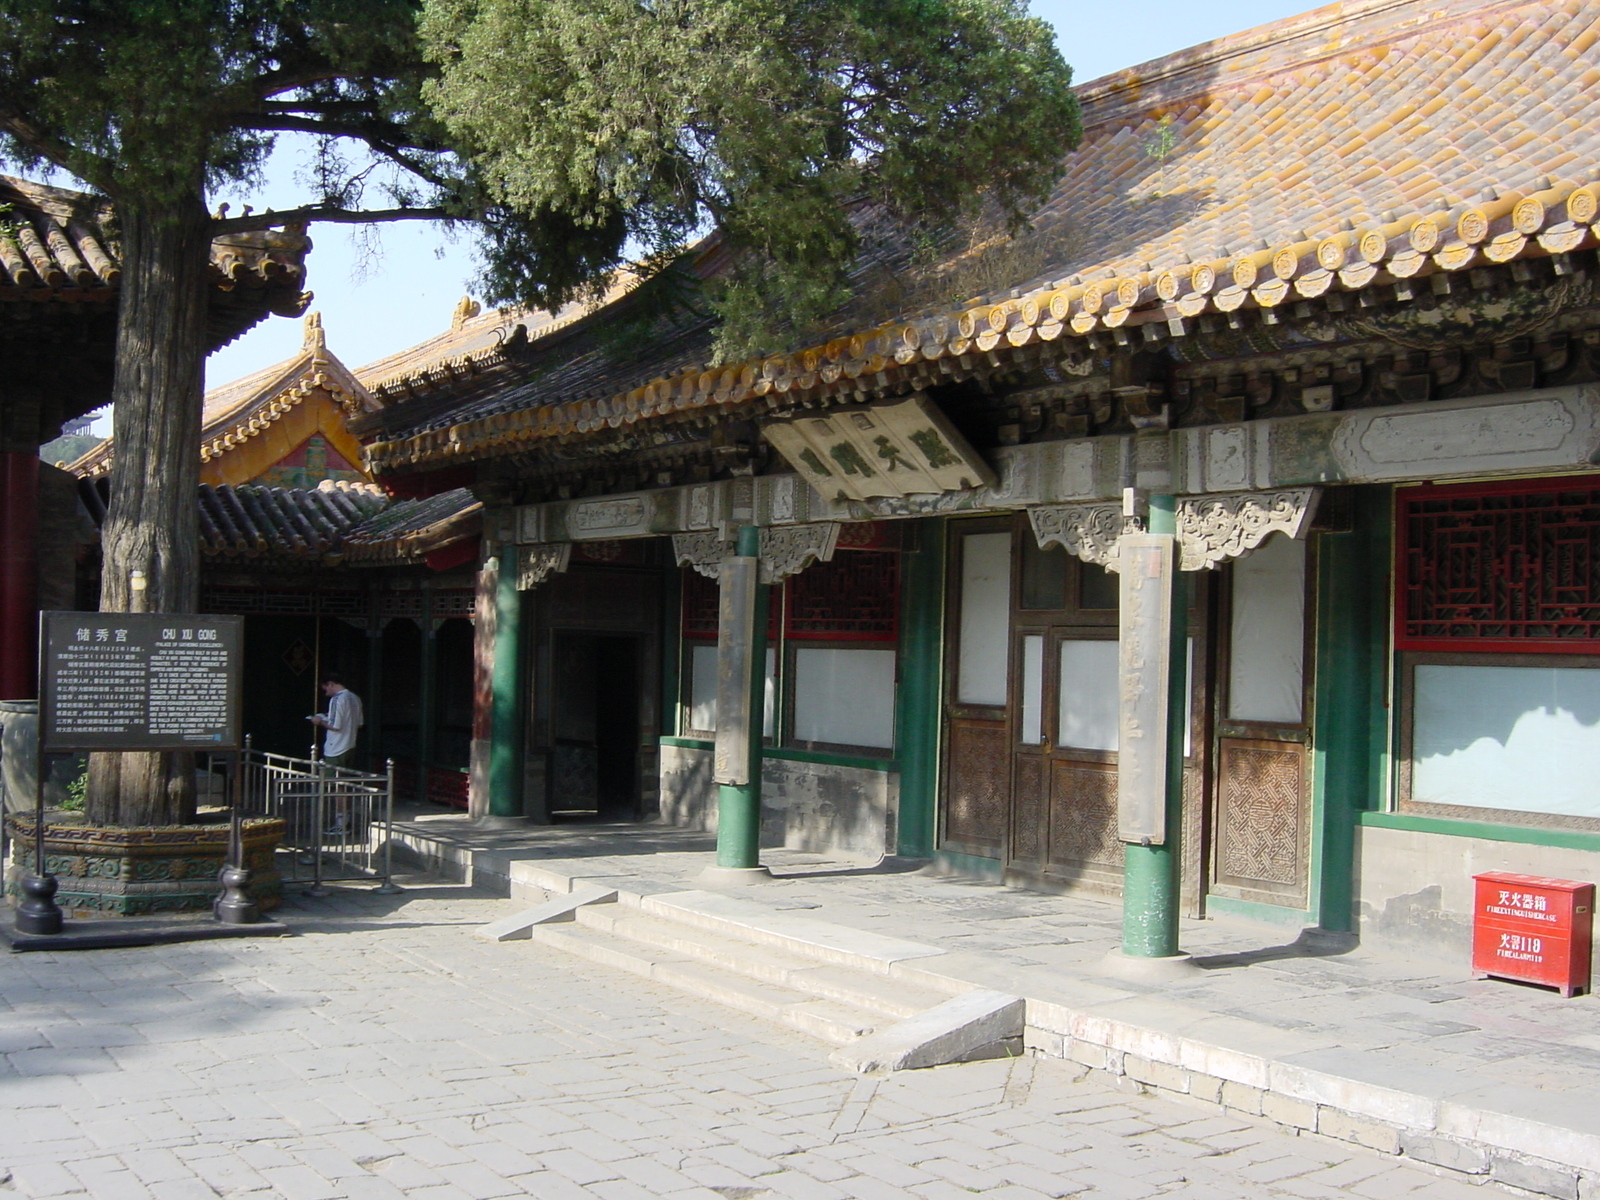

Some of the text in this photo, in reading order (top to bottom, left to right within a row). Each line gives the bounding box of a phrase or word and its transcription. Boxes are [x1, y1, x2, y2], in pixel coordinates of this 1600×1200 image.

[77, 628, 128, 642] 储秀宫
[162, 628, 217, 641] CHU XIU GONG
[1498, 890, 1547, 911] 灭火器箱
[1499, 933, 1541, 952] 火警119
